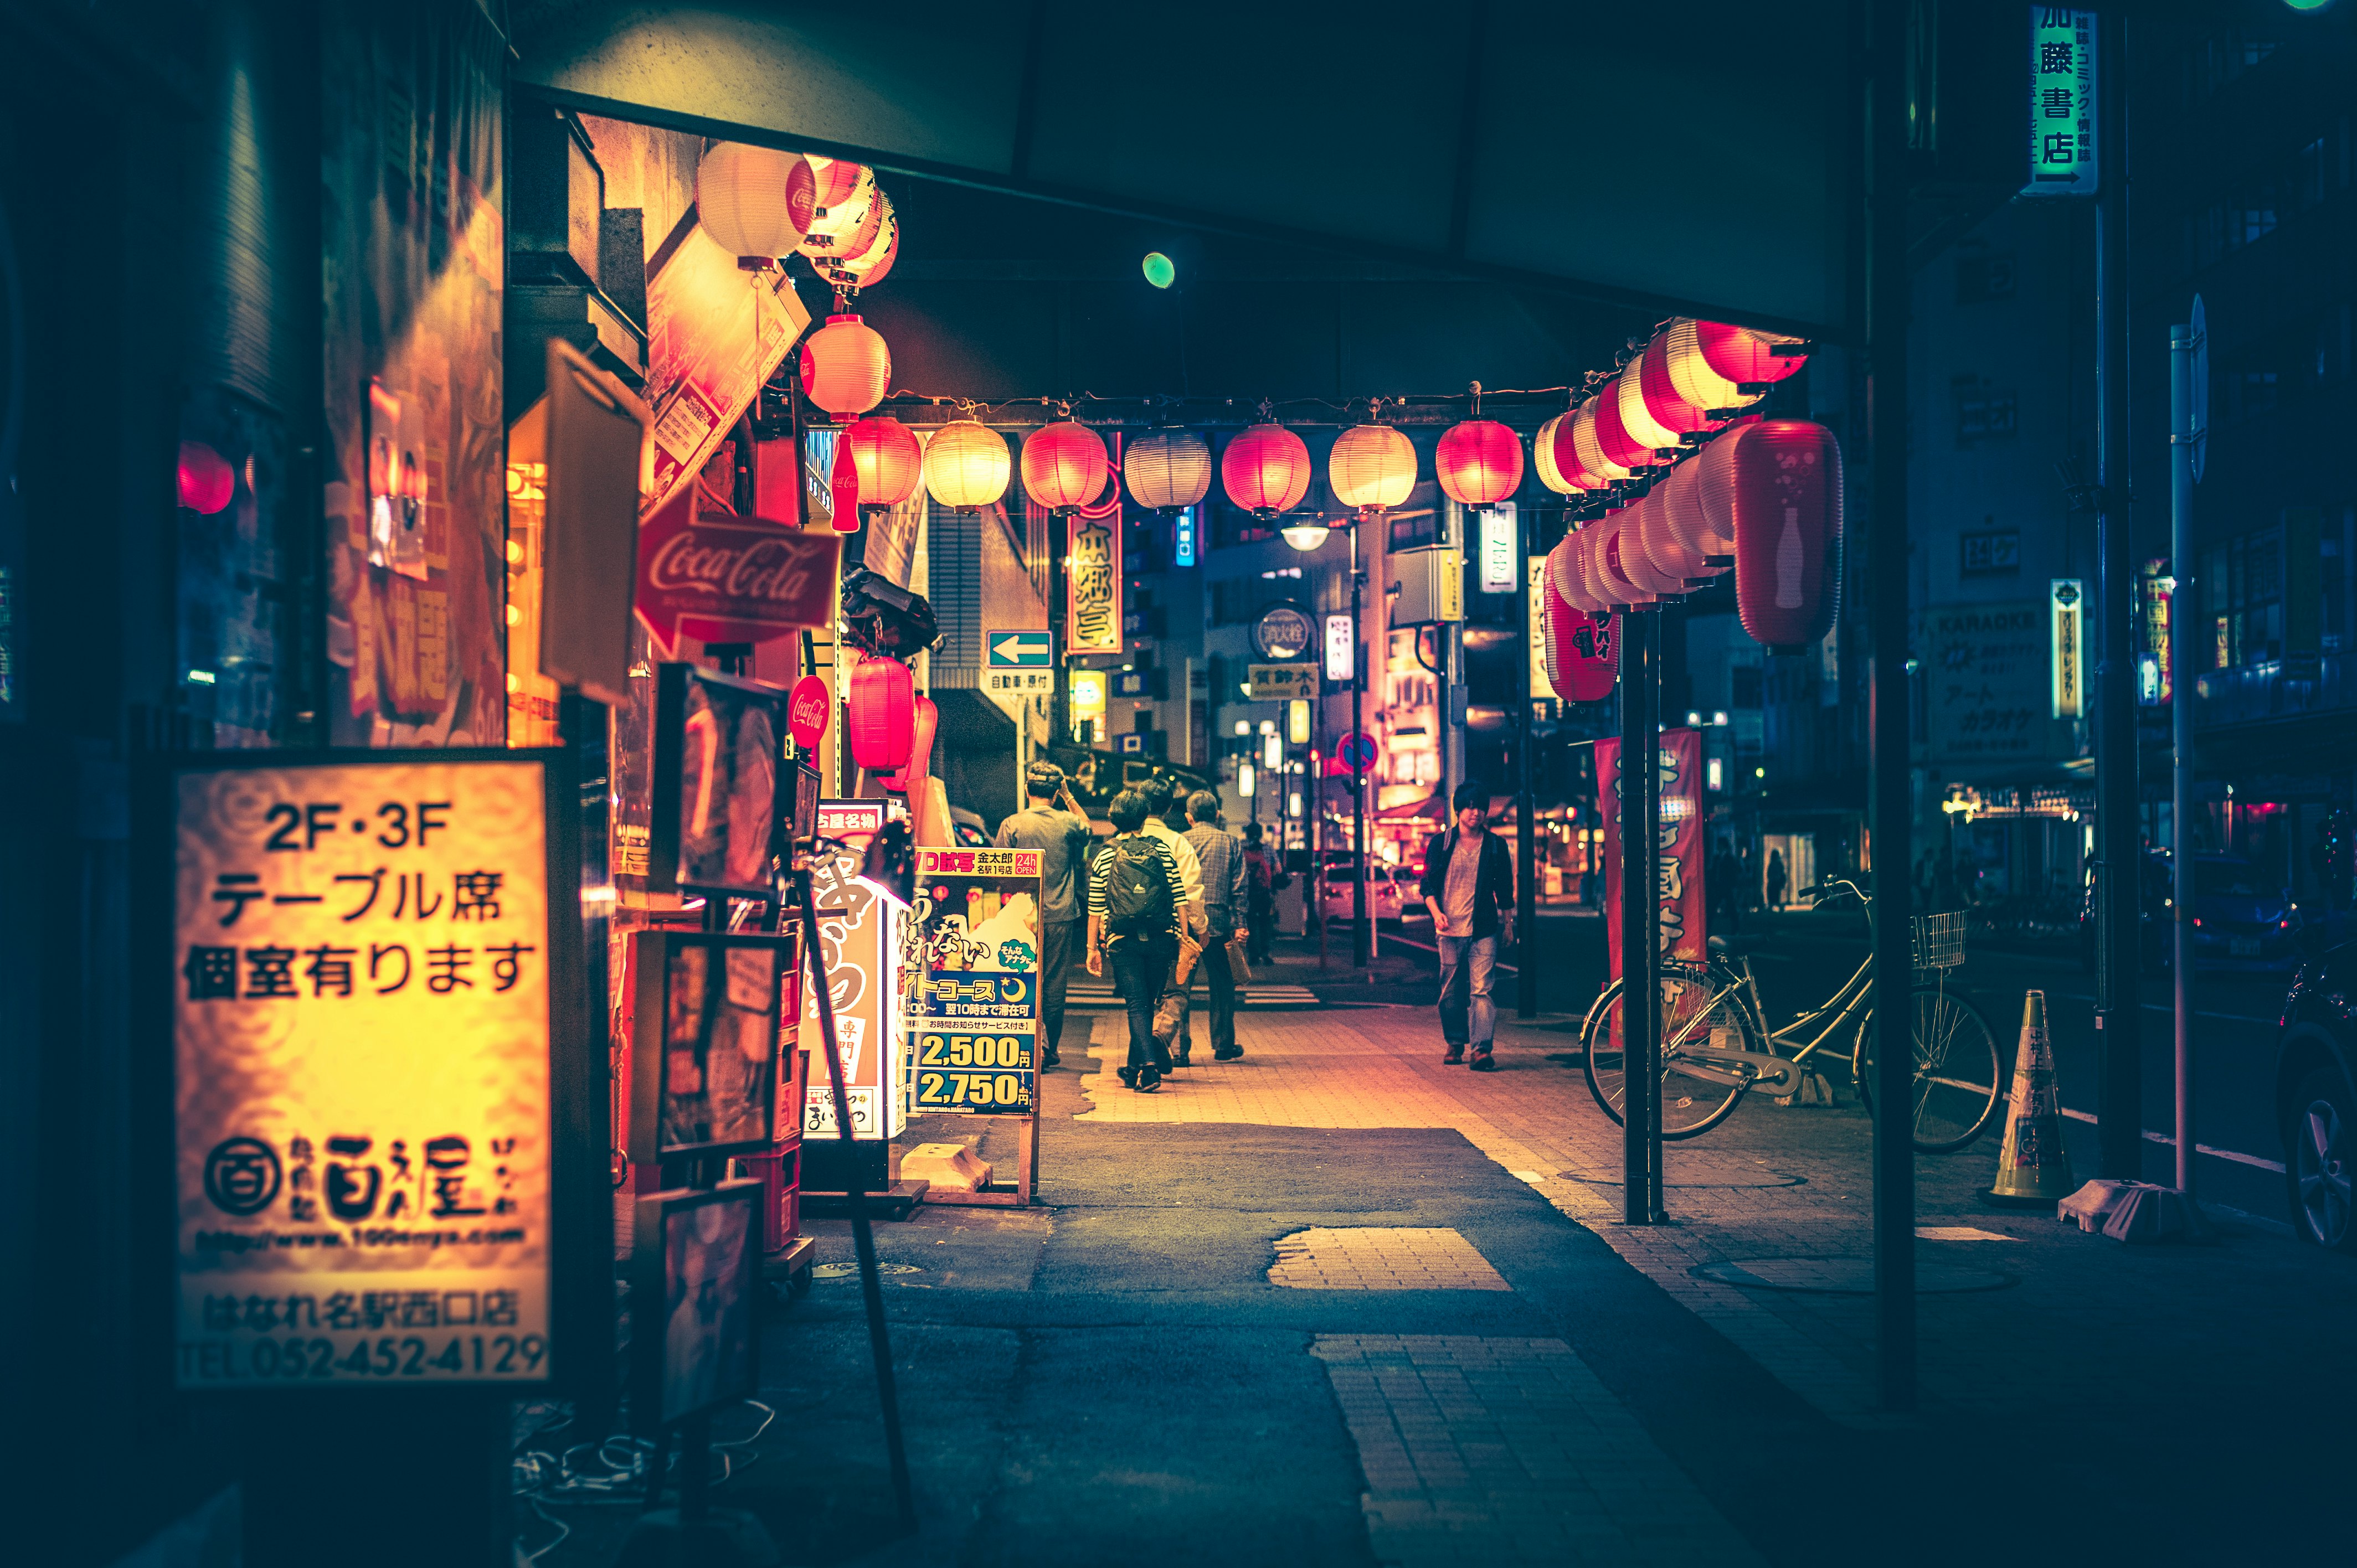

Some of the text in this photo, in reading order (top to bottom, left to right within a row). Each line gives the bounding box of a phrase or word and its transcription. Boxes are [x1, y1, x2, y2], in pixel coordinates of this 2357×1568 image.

[2075, 11, 2091, 162] 雑誌・コミック・情報誌
[977, 852, 1013, 864] 金太郎
[1016, 854, 1036, 866] 24h
[212, 867, 504, 929] テーブル席
[1001, 946, 1023, 956] そんな
[183, 940, 537, 1002] 個室有ります
[945, 1003, 1030, 1017] 翌10時まで滞在可
[201, 1290, 519, 1329] はなれ名駅西口店
